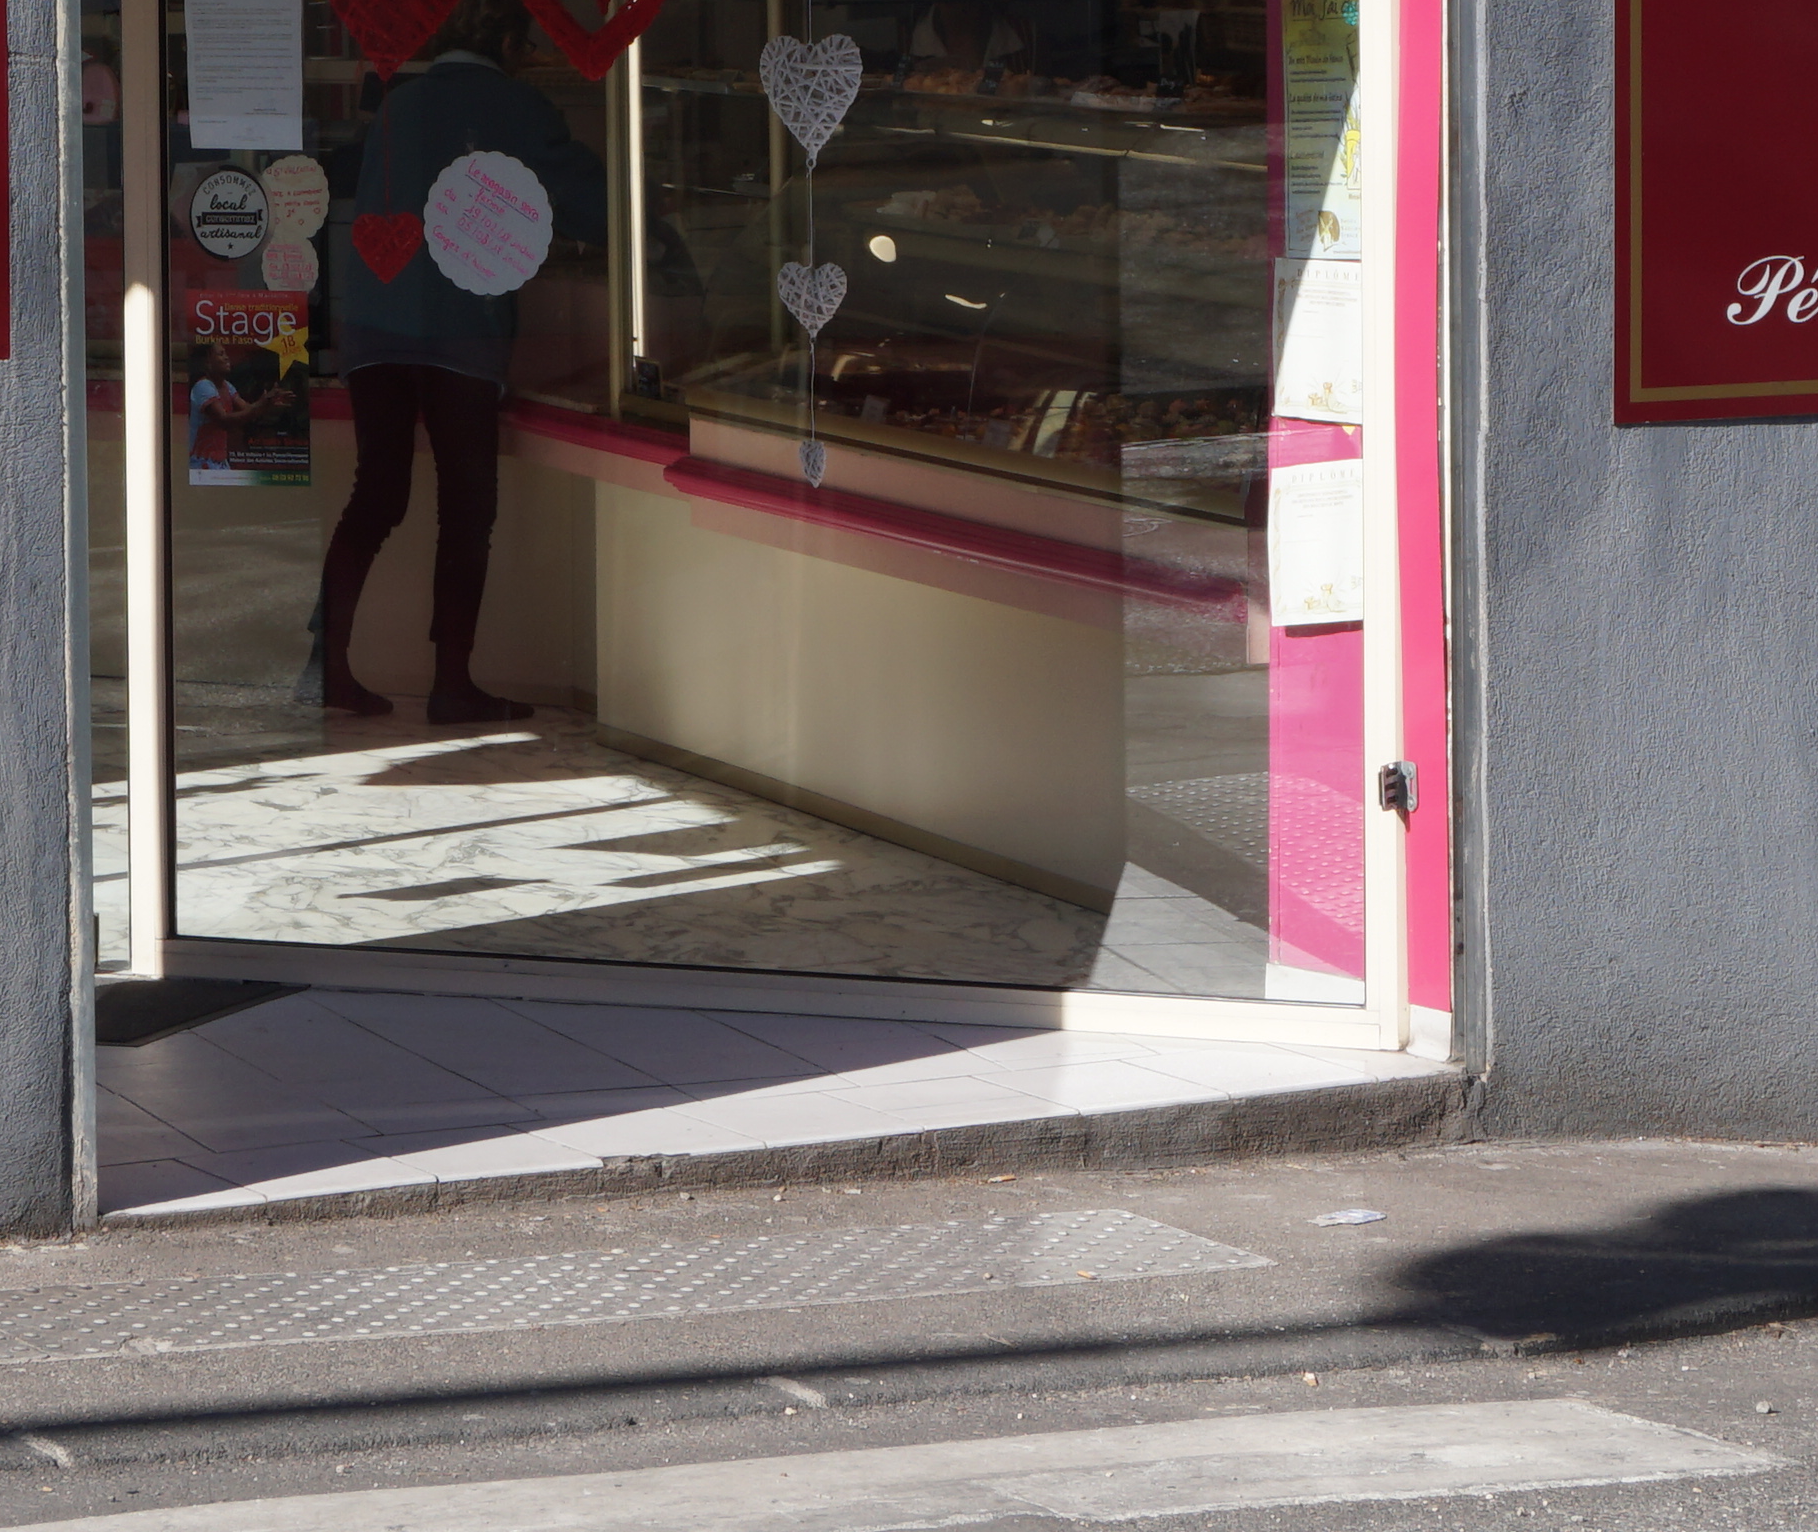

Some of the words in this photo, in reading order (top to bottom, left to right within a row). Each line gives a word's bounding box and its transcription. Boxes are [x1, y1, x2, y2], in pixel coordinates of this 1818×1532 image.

[468, 159, 480, 179] Le
[203, 174, 256, 197] CONSOMMEZ
[209, 193, 248, 210] local
[200, 225, 263, 239] artisanal
[195, 299, 297, 346] Stage
[195, 334, 230, 344] Burkina
[232, 334, 254, 344] Faso
